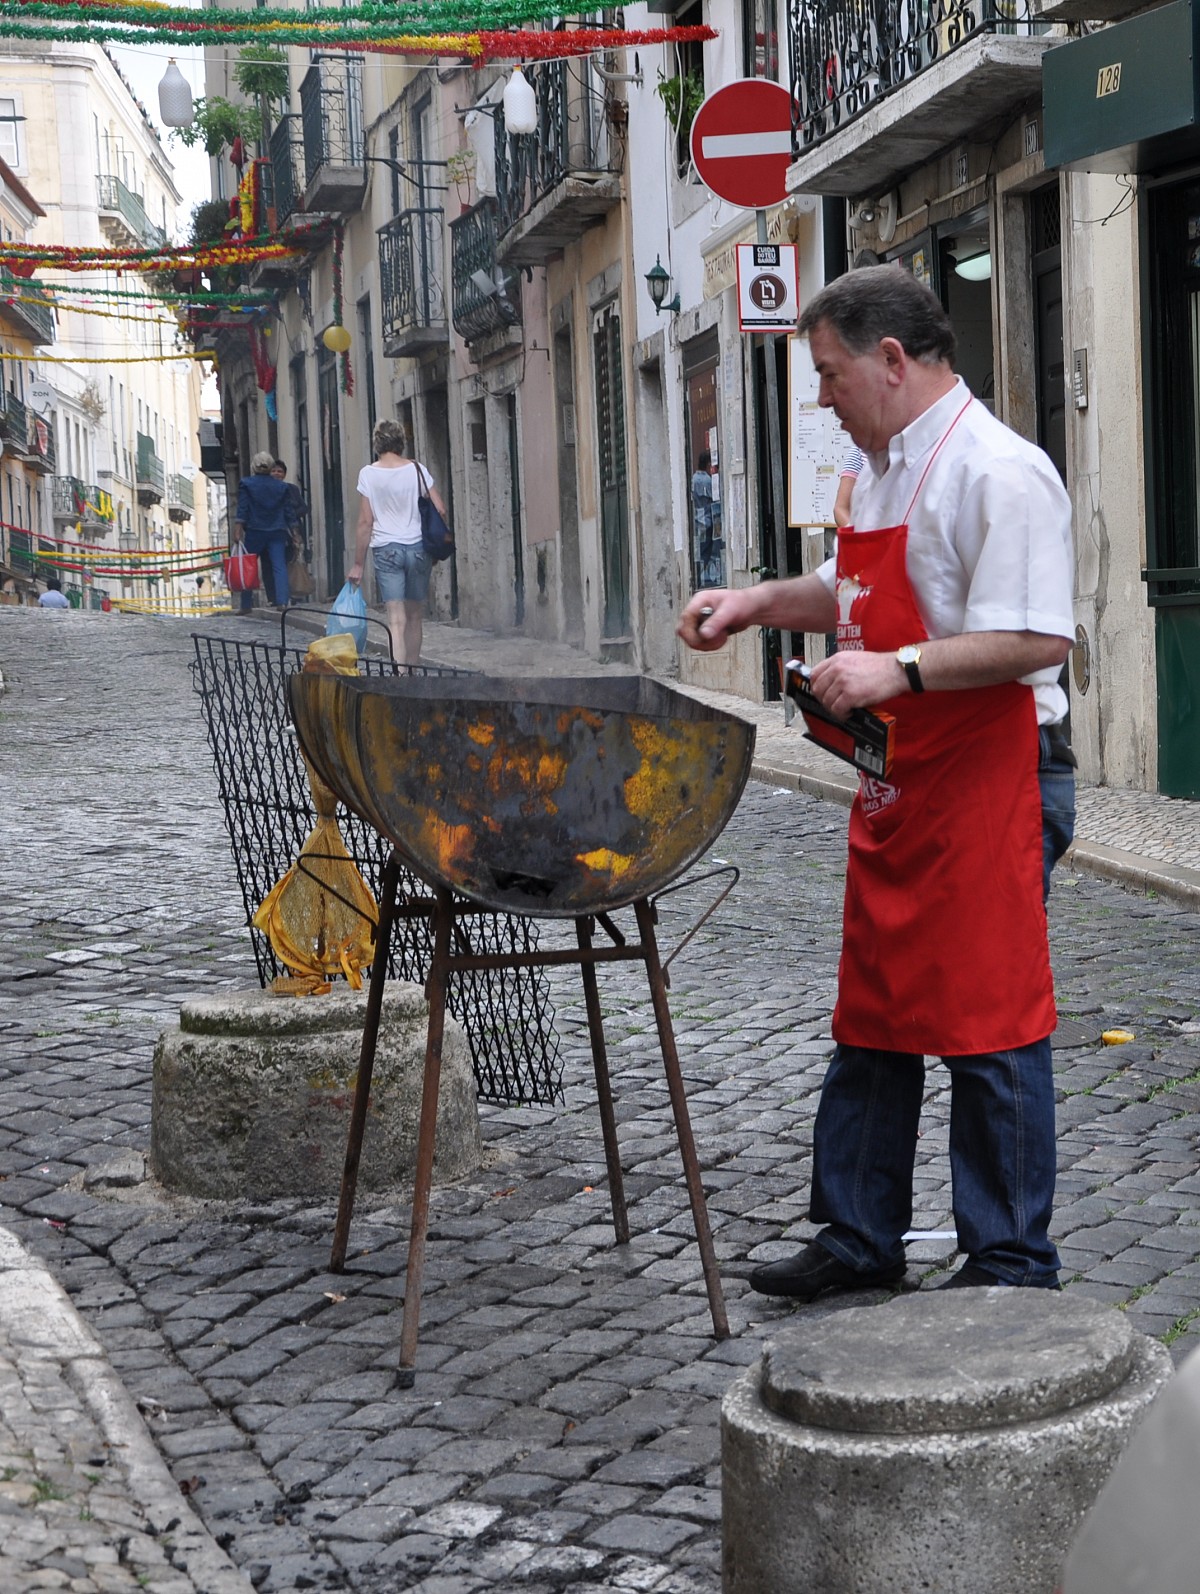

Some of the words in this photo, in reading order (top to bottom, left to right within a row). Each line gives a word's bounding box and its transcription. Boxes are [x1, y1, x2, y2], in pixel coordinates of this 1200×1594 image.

[1099, 65, 1120, 95] 128
[1025, 123, 1037, 155] 130
[757, 246, 776, 256] CUIDA
